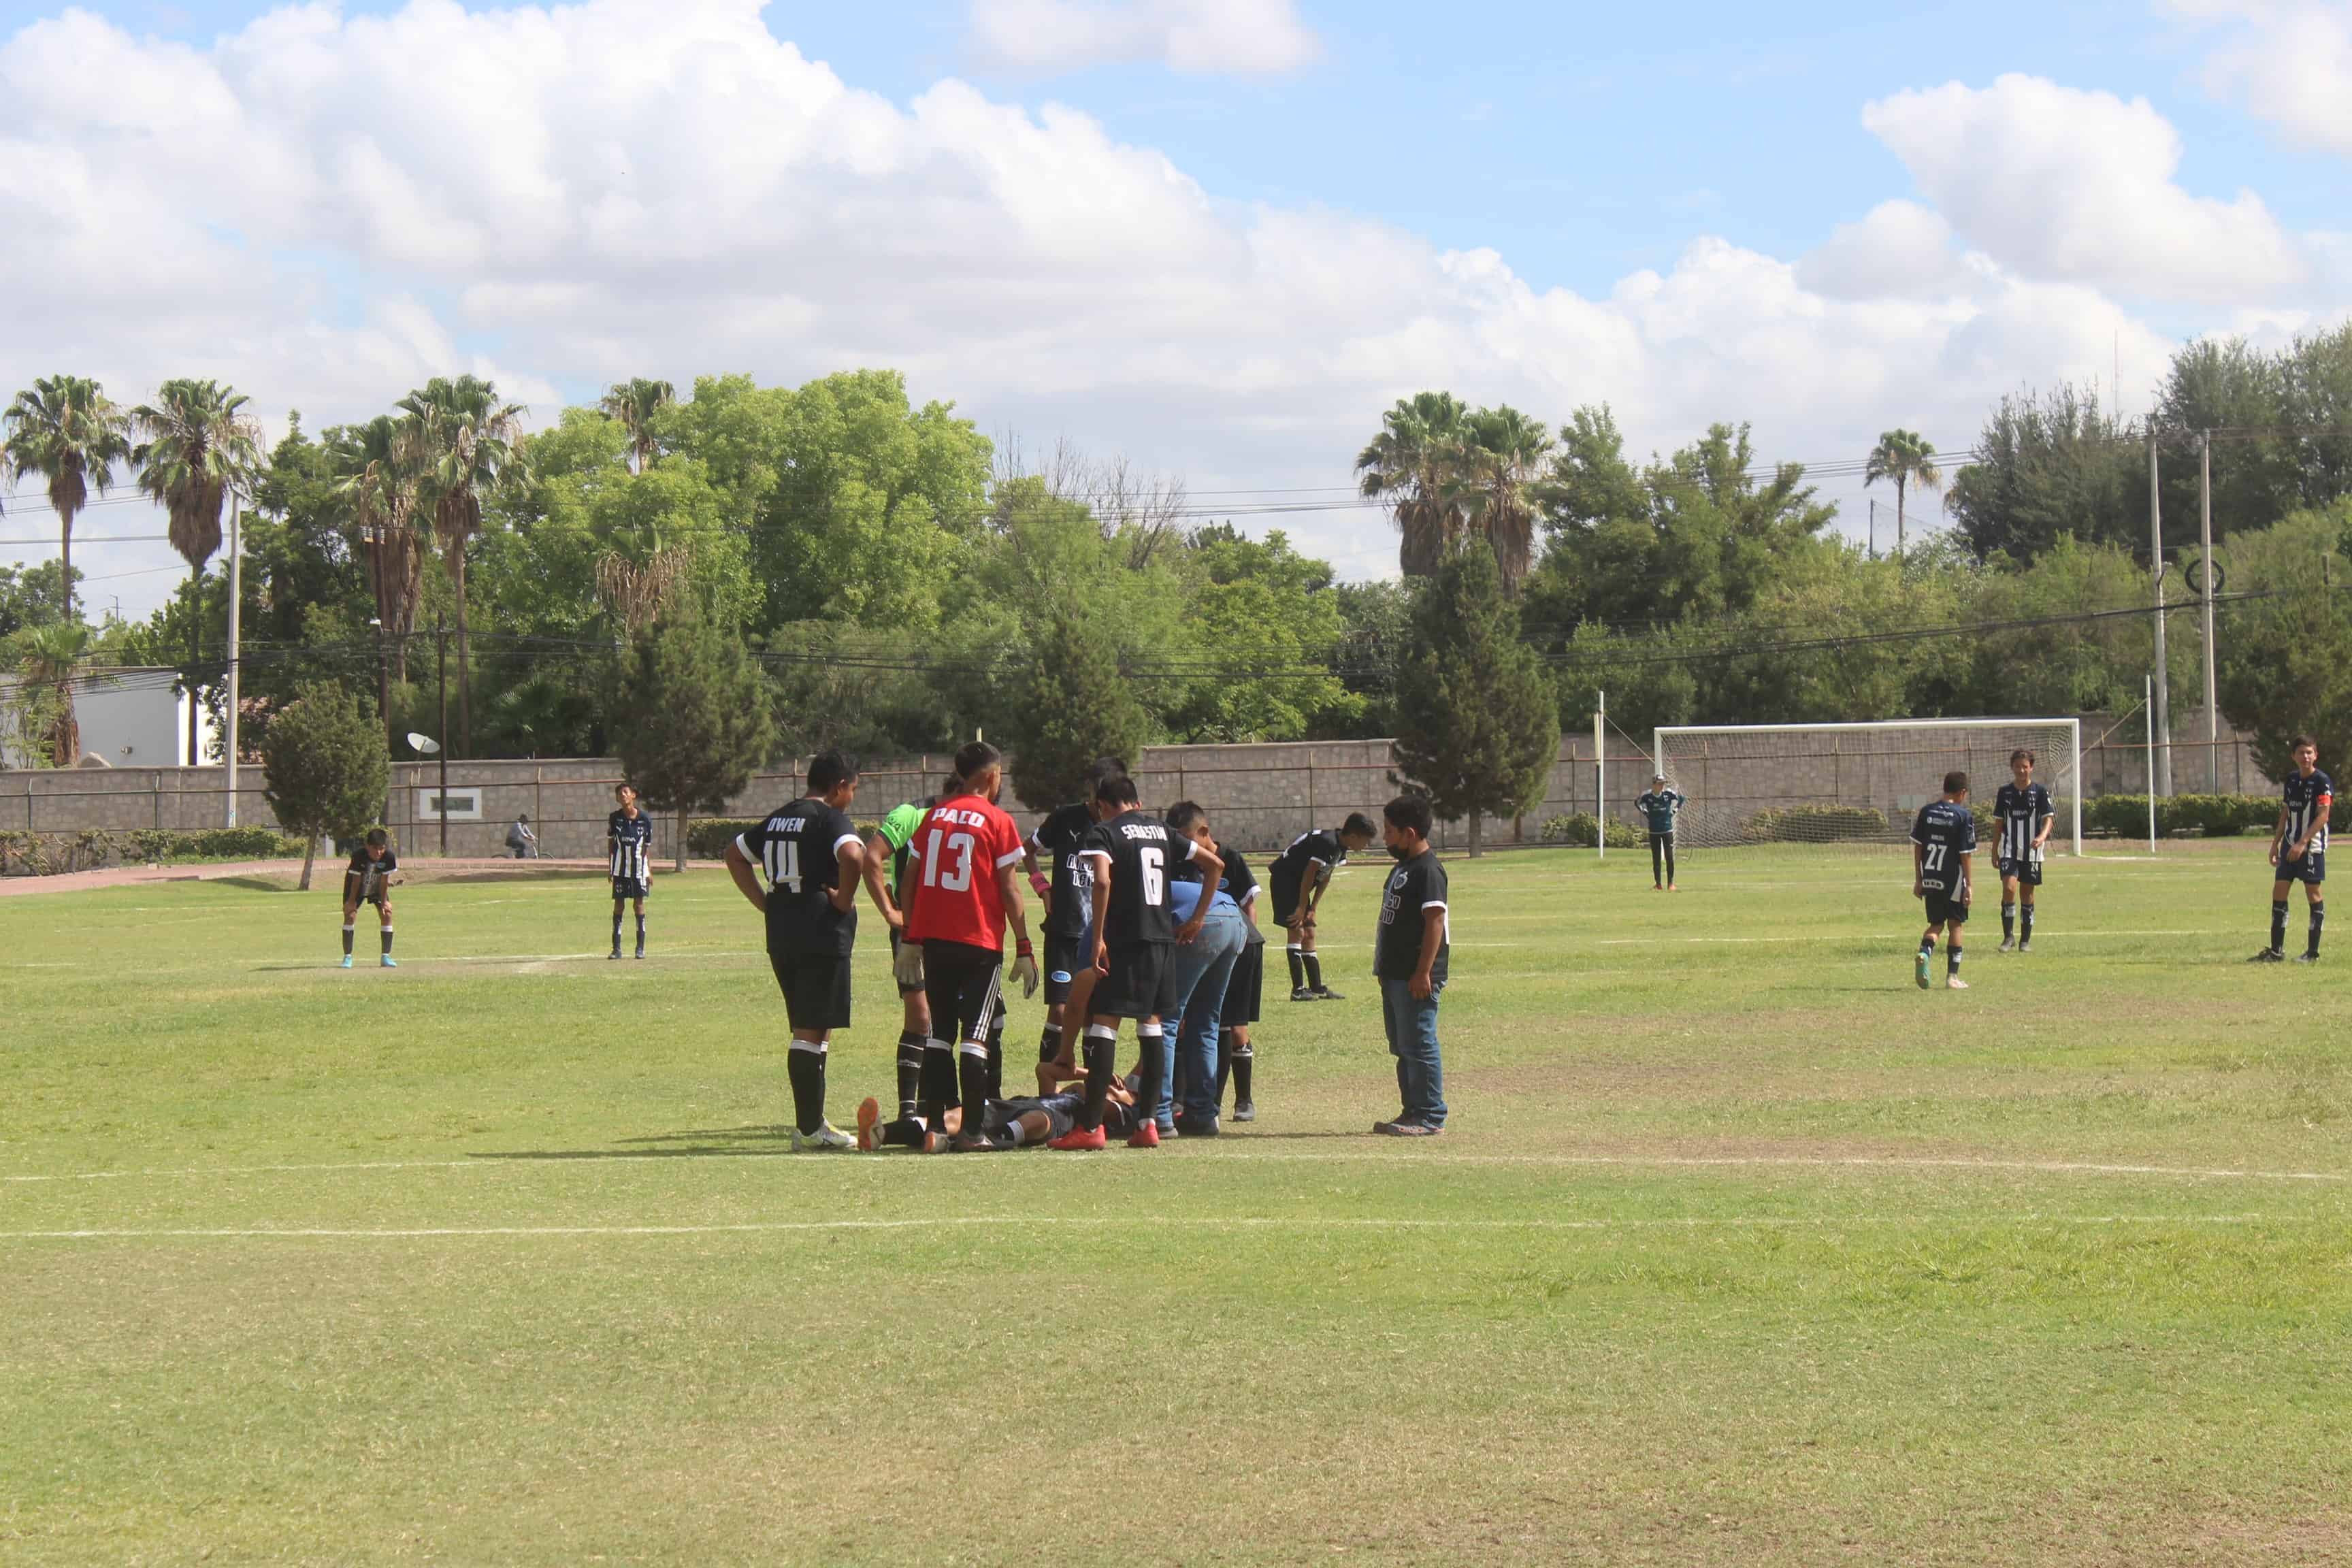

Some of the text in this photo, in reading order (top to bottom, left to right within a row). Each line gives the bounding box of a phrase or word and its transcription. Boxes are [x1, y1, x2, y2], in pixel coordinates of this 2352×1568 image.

[767, 817, 806, 832] OWEN
[931, 807, 986, 828] PACO
[764, 840, 802, 893] 14
[924, 828, 975, 892] 13
[1141, 847, 1164, 906] 6
[1925, 843, 1948, 871] 27
